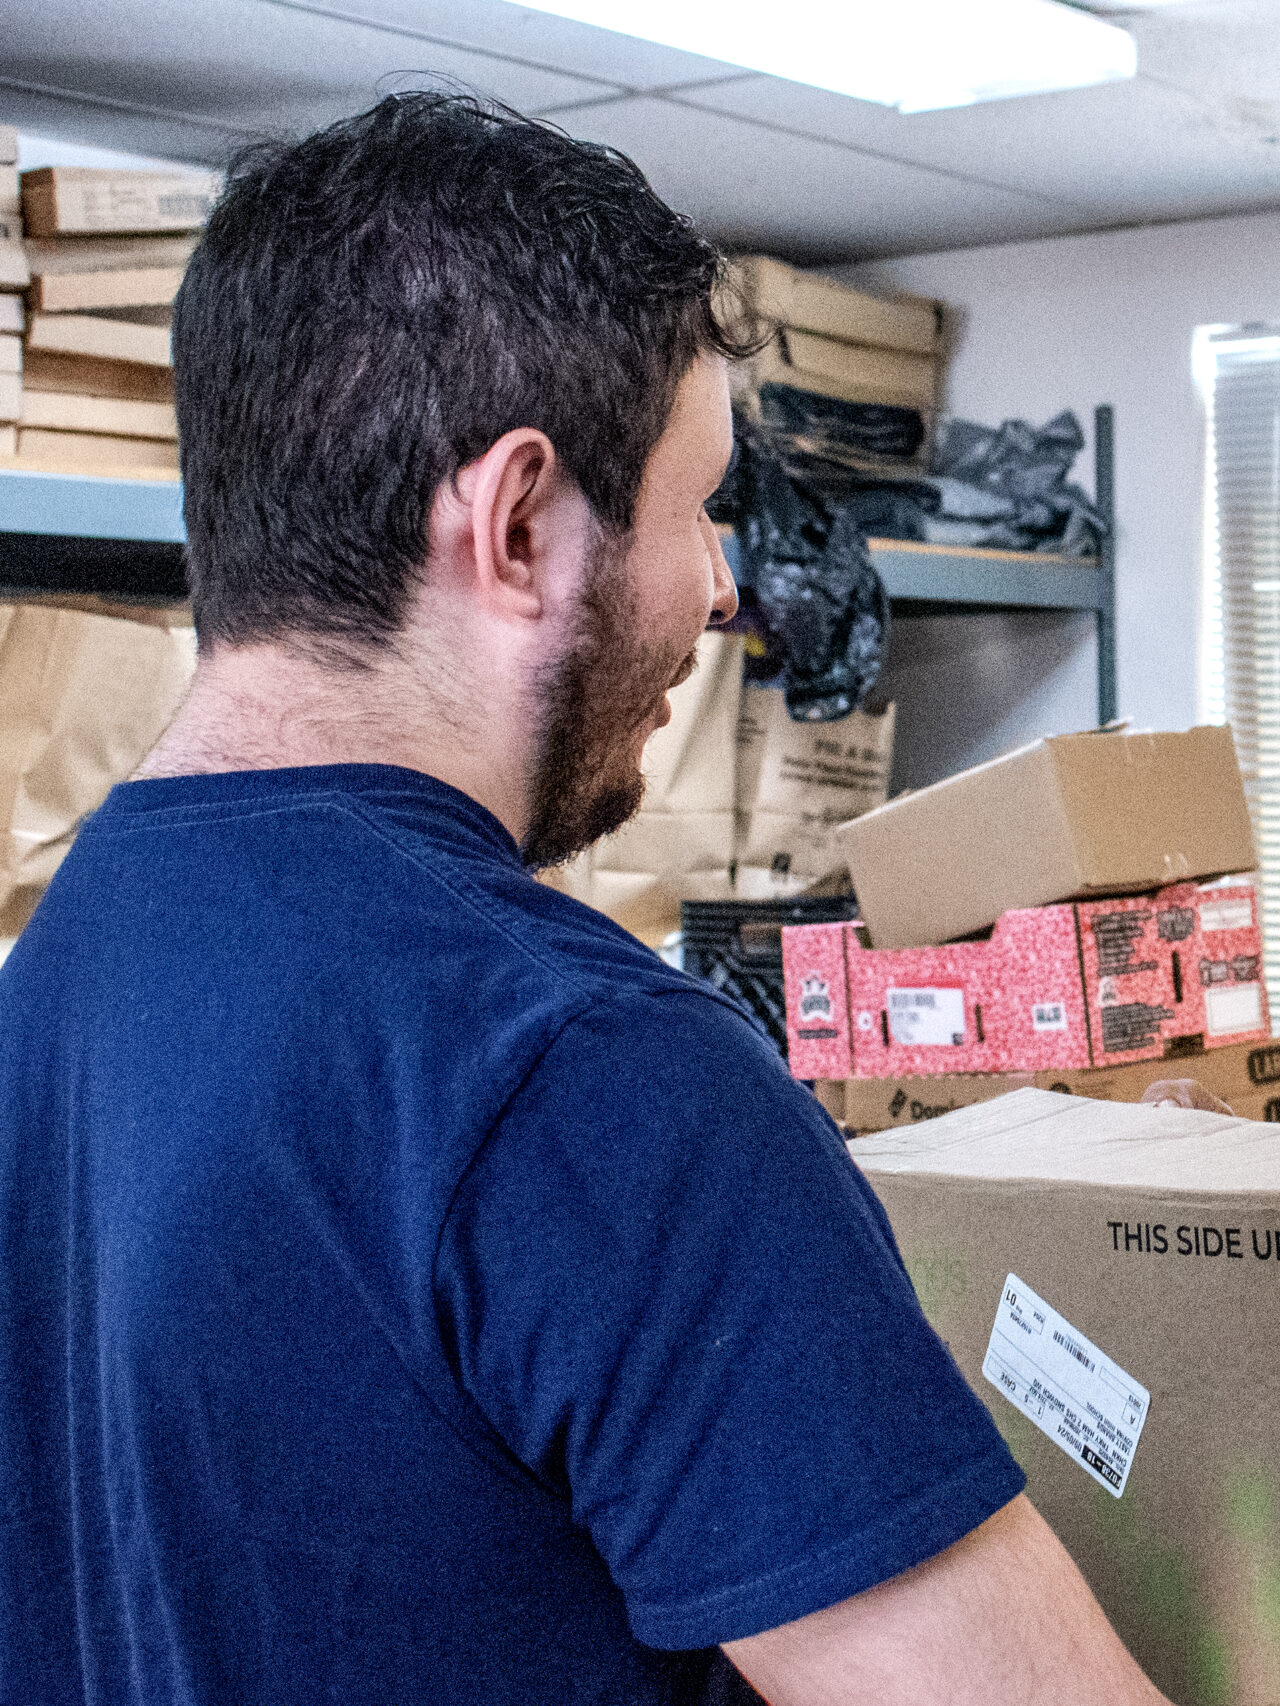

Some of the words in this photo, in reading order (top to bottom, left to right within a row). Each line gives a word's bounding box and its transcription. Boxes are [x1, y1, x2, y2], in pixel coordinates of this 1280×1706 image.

[1107, 1221, 1169, 1254] THIS
[1176, 1225, 1243, 1259] SIDE
[1005, 1288, 1017, 1307] 01
[999, 1370, 1016, 1392] CASE
[1082, 1422, 1094, 1438] HAM
